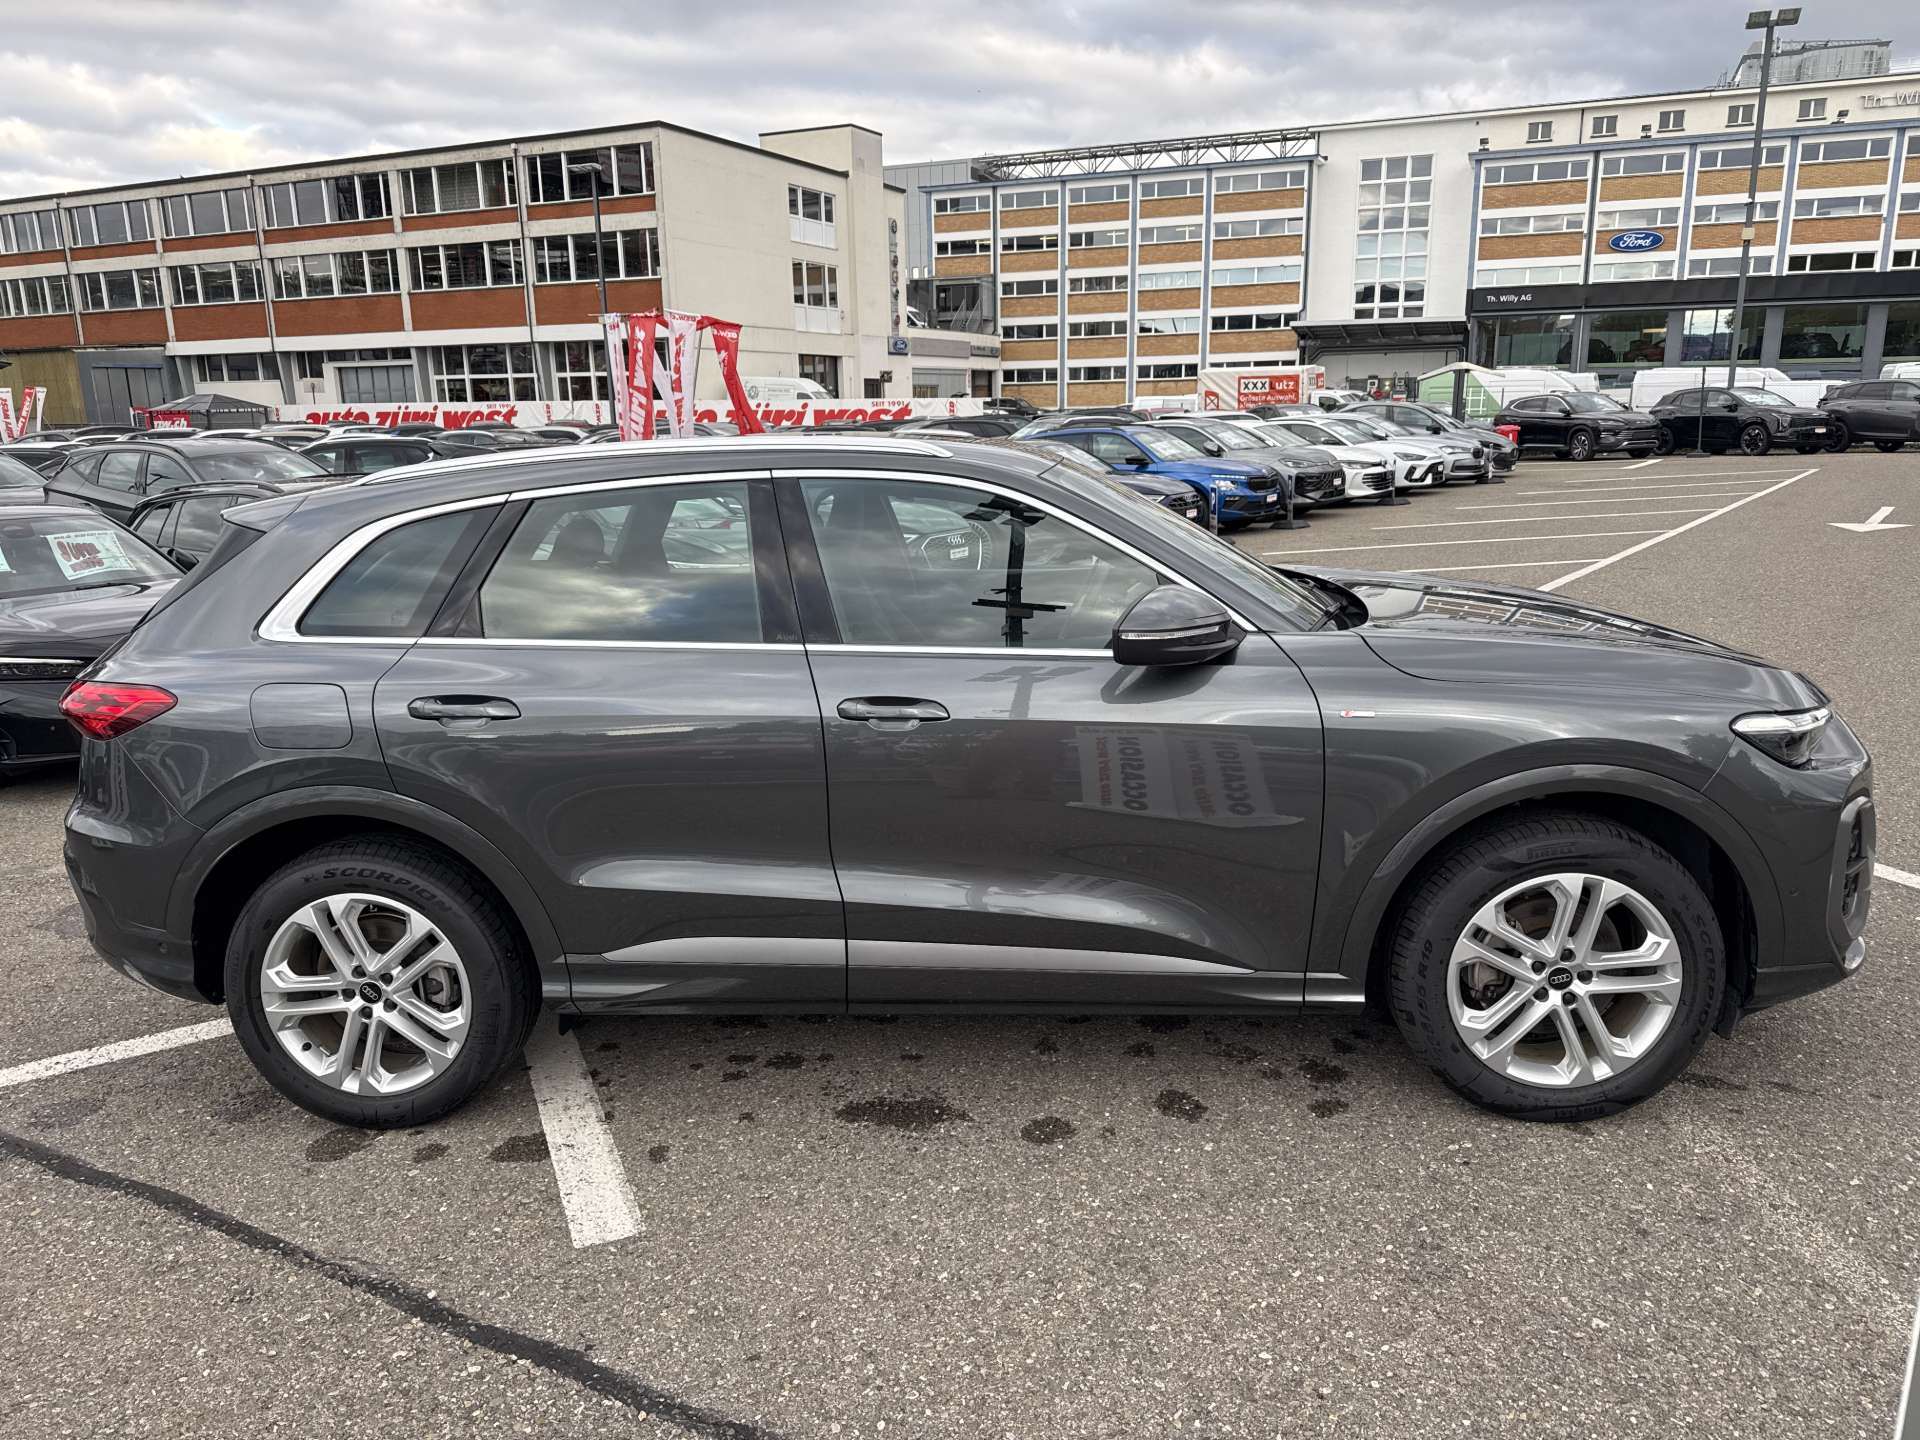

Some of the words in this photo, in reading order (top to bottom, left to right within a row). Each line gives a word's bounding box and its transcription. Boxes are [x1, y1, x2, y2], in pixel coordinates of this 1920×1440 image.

[1486, 295, 1498, 303] Th.
[1500, 294, 1519, 304] Willy
[1520, 293, 1532, 302] AG
[442, 404, 518, 430] west
